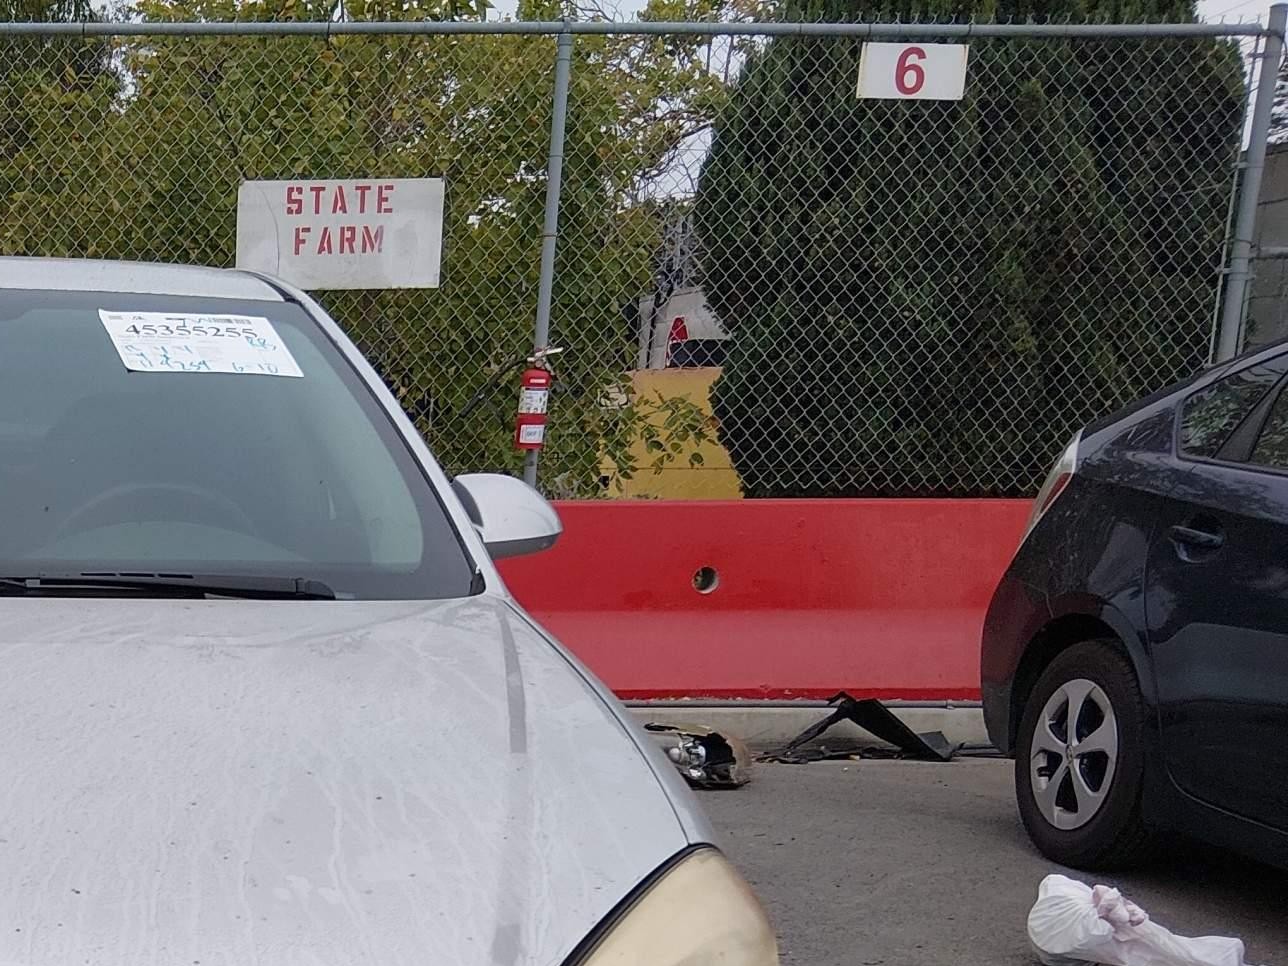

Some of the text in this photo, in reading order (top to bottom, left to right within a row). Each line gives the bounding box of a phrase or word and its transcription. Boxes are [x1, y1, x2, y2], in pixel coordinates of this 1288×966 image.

[894, 46, 927, 96] 6
[285, 184, 394, 215] STATE
[294, 225, 384, 256] FARM
[125, 323, 258, 338] 45355255
